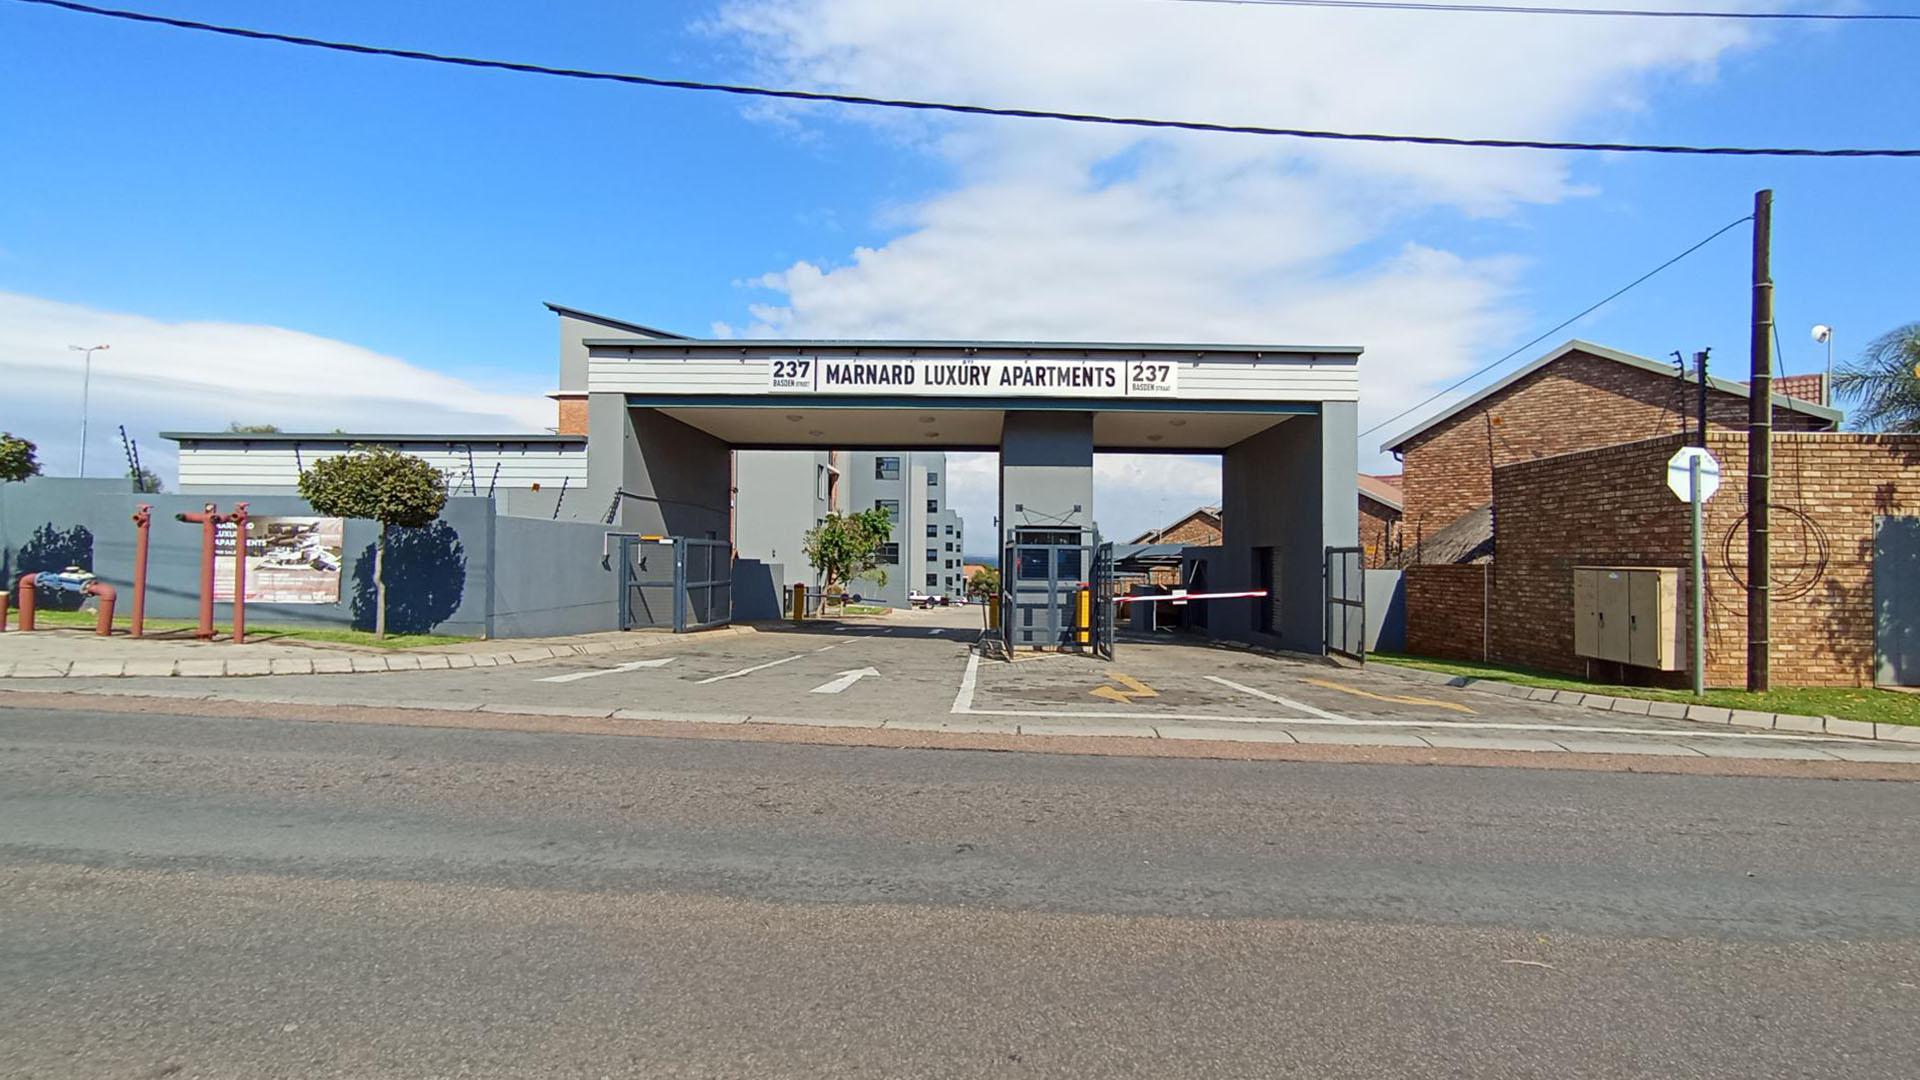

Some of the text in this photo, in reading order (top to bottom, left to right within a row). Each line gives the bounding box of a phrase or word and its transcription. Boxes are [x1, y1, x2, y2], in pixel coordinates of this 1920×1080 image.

[773, 361, 810, 378] 237
[826, 364, 1116, 388] MARNARD LUXURY APARTMENTS
[1132, 365, 1170, 382] 237
[214, 538, 267, 547] APARENTS
